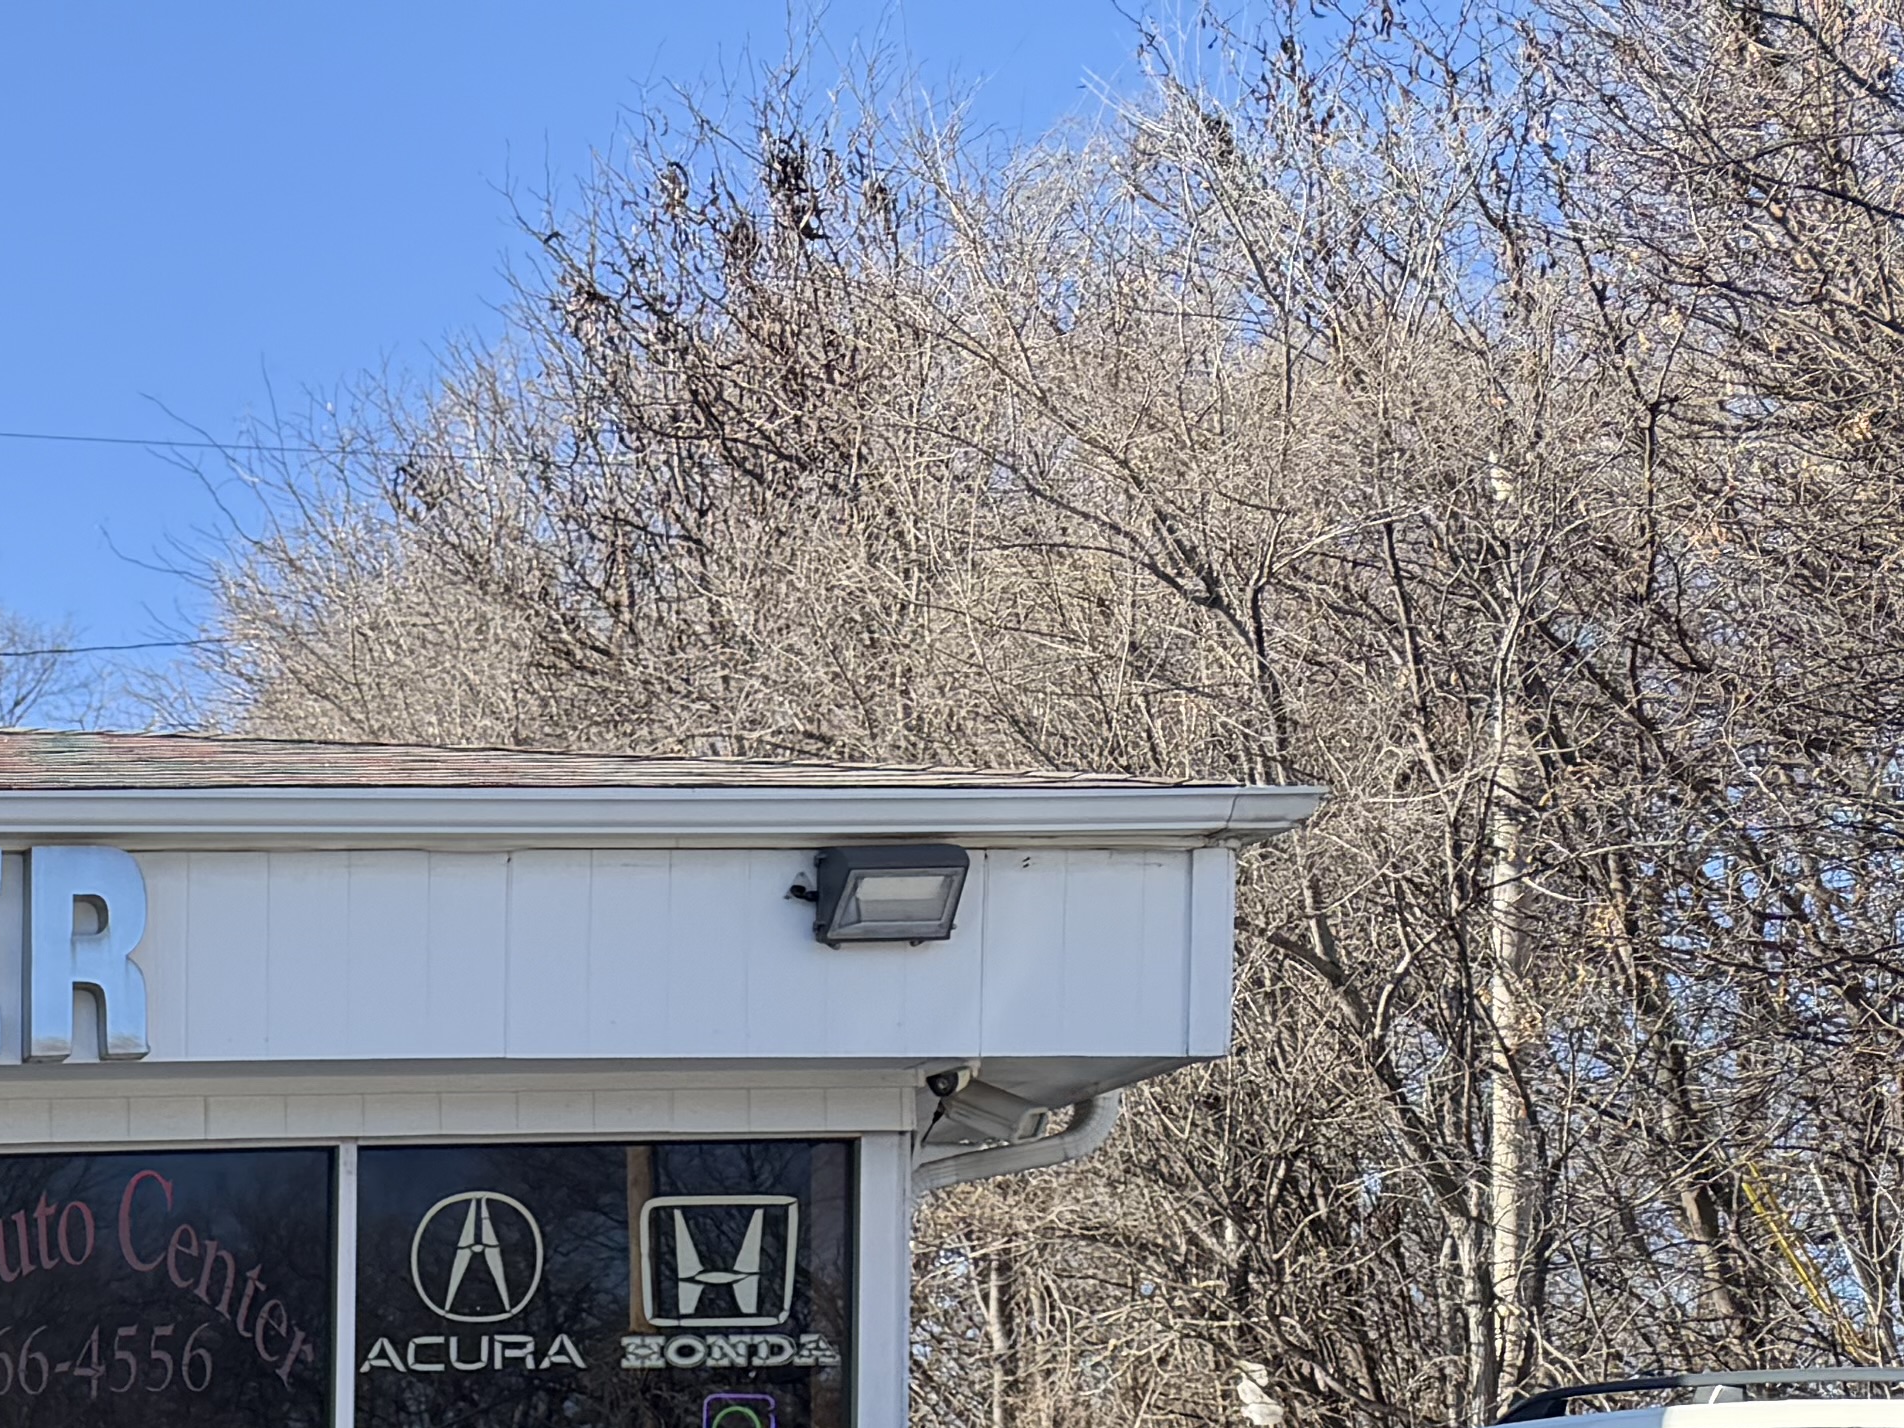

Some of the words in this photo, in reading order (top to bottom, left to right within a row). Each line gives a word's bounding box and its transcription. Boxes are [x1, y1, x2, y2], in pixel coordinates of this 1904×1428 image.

[117, 1168, 315, 1393] Center
[358, 1332, 588, 1374] ACURA
[620, 1332, 842, 1369] HONDA
